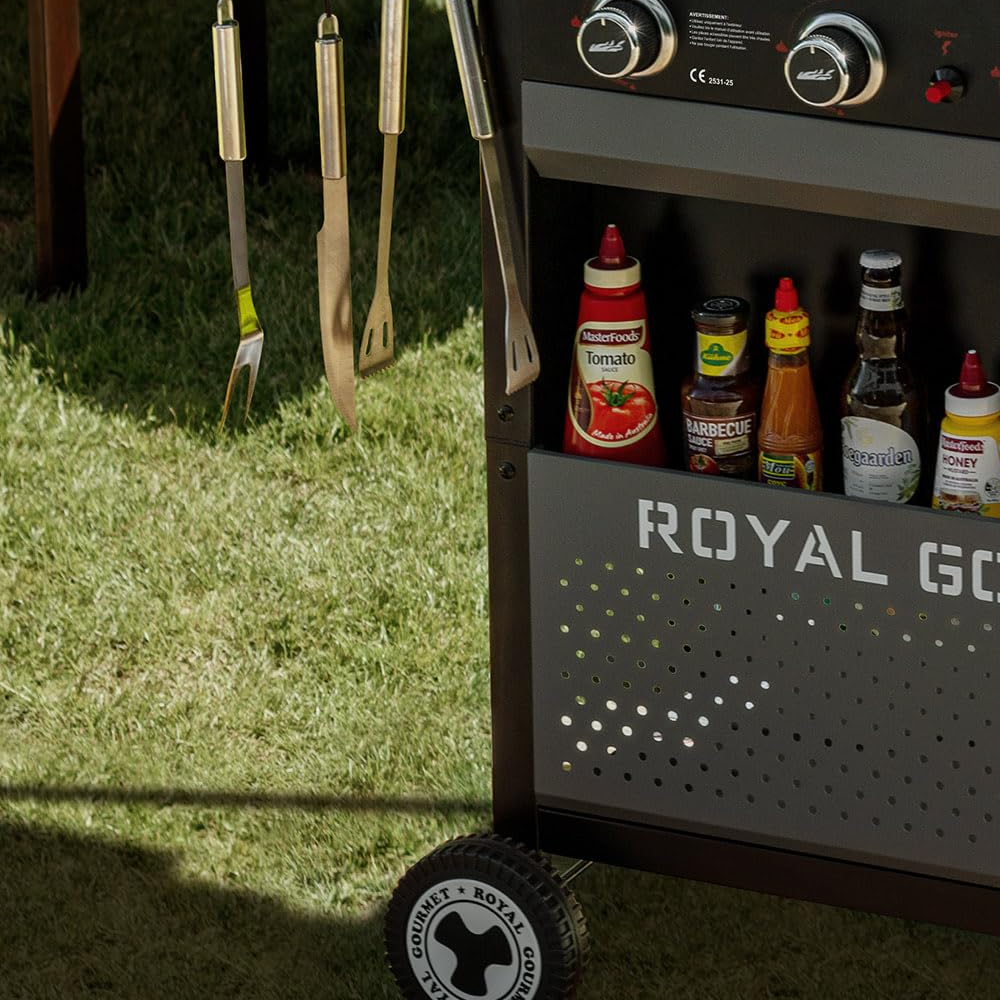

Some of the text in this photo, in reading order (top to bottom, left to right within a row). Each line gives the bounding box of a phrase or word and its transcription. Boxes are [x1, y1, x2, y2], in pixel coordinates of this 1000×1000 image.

[708, 77, 734, 87] 2531-25
[582, 330, 641, 342] MasterFoods
[585, 350, 636, 366] Tomato
[686, 417, 753, 438] BARBECUE
[687, 433, 713, 448] SAUCE
[942, 453, 978, 469] HONEY
[637, 498, 889, 587] ROYAL
[411, 887, 450, 960] GOURMET
[473, 886, 525, 935] ROYAL
